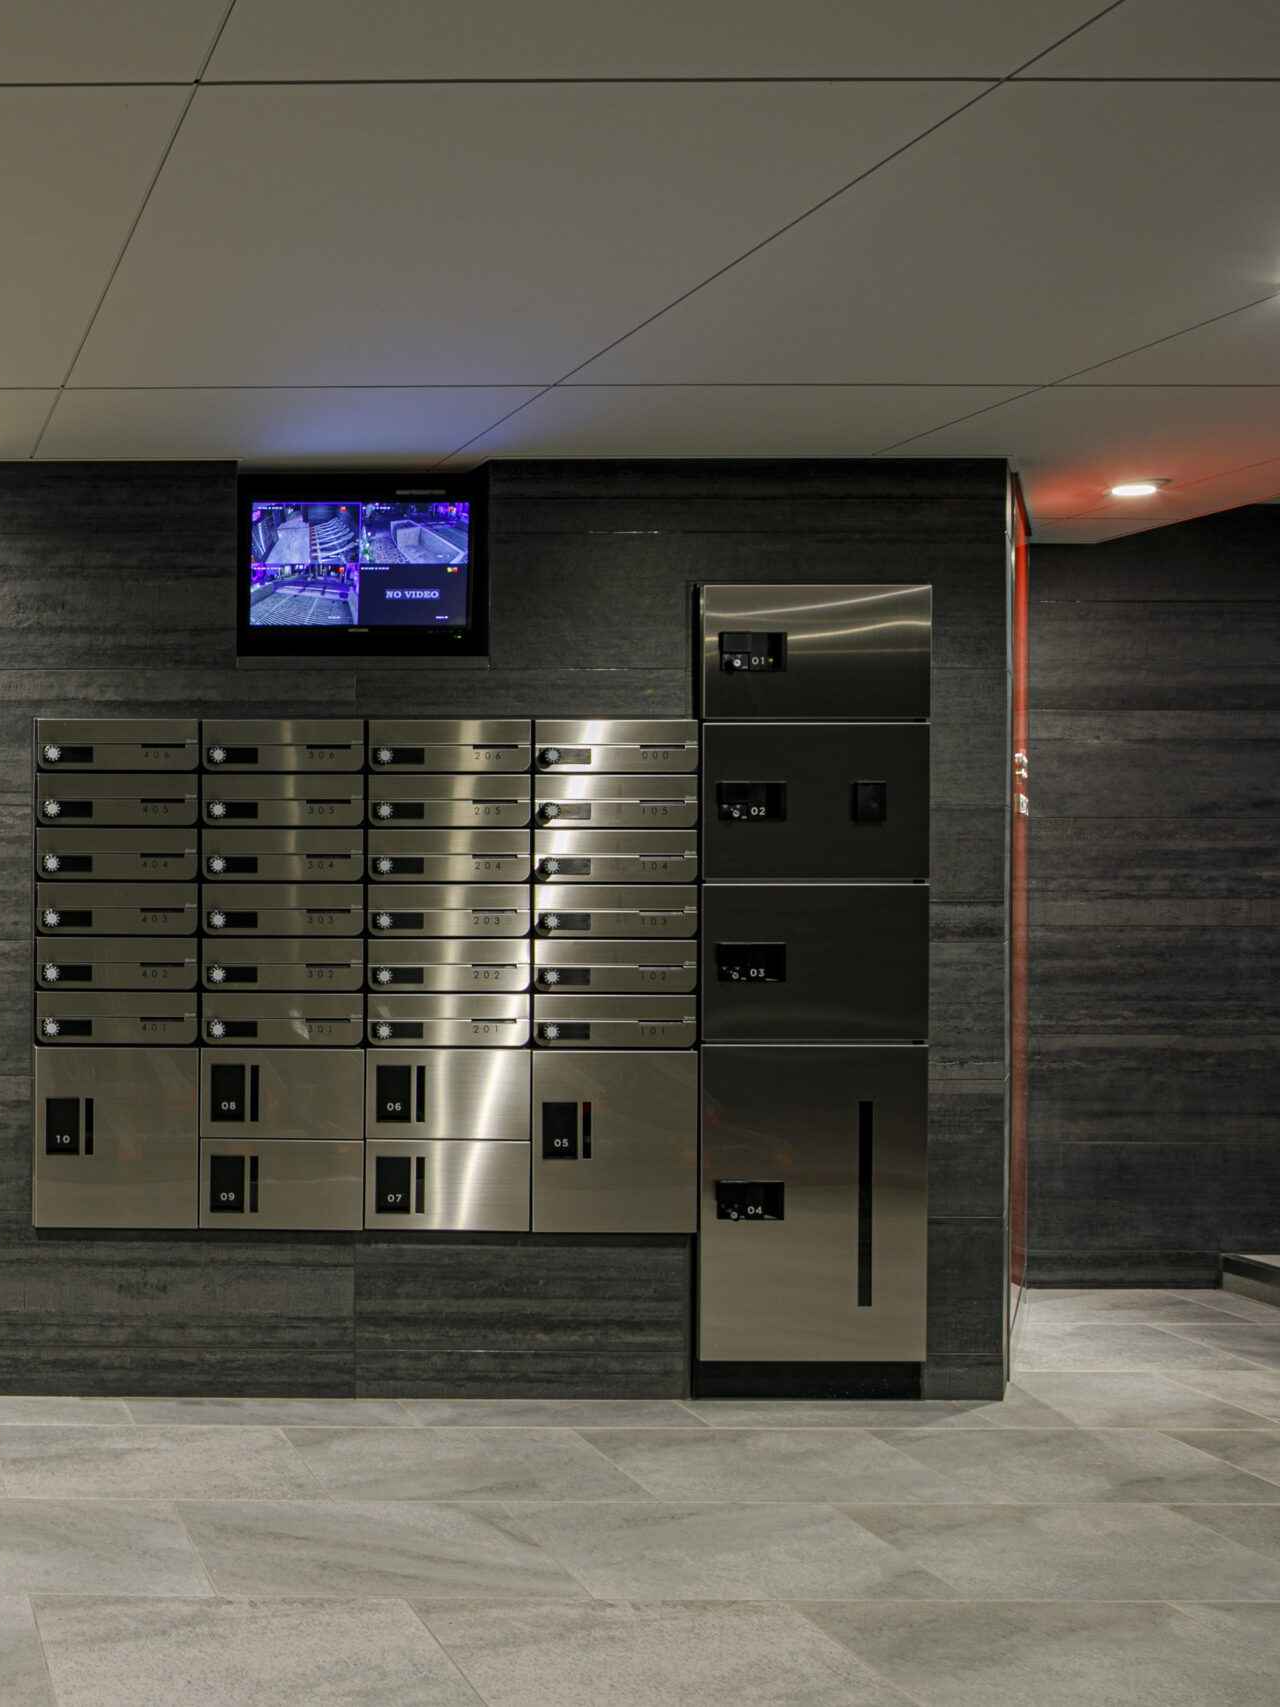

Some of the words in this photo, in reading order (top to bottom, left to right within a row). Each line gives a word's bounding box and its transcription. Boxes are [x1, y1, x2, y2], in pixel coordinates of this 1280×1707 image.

[385, 590, 402, 599] NO
[404, 590, 439, 599] VIDEO
[751, 657, 765, 665] 01
[475, 751, 502, 760] 206
[142, 806, 170, 814] 405
[307, 806, 335, 815] 305
[475, 806, 502, 815] 205
[641, 806, 670, 815] 105
[750, 807, 766, 816] 02
[142, 861, 170, 869] 404
[307, 861, 335, 869] 304
[475, 861, 502, 870] 204
[641, 861, 670, 870] 104
[141, 915, 168, 924] 403
[307, 916, 334, 924] 303
[473, 916, 501, 925] 203
[640, 917, 667, 926] 103
[141, 970, 168, 978] 402
[307, 970, 334, 979] 302
[473, 971, 501, 979] 202
[640, 972, 667, 980] 102
[750, 969, 765, 977] 03
[141, 1024, 168, 1032] 401
[307, 1024, 334, 1032] 301
[473, 1025, 501, 1034] 201
[640, 1026, 667, 1035] 101
[221, 1102, 236, 1110] 08
[386, 1102, 402, 1111] 06
[55, 1135, 71, 1144] 10
[554, 1139, 569, 1147] 05
[220, 1192, 235, 1201] 09
[387, 1194, 403, 1202] 07
[747, 1206, 763, 1215] 04
